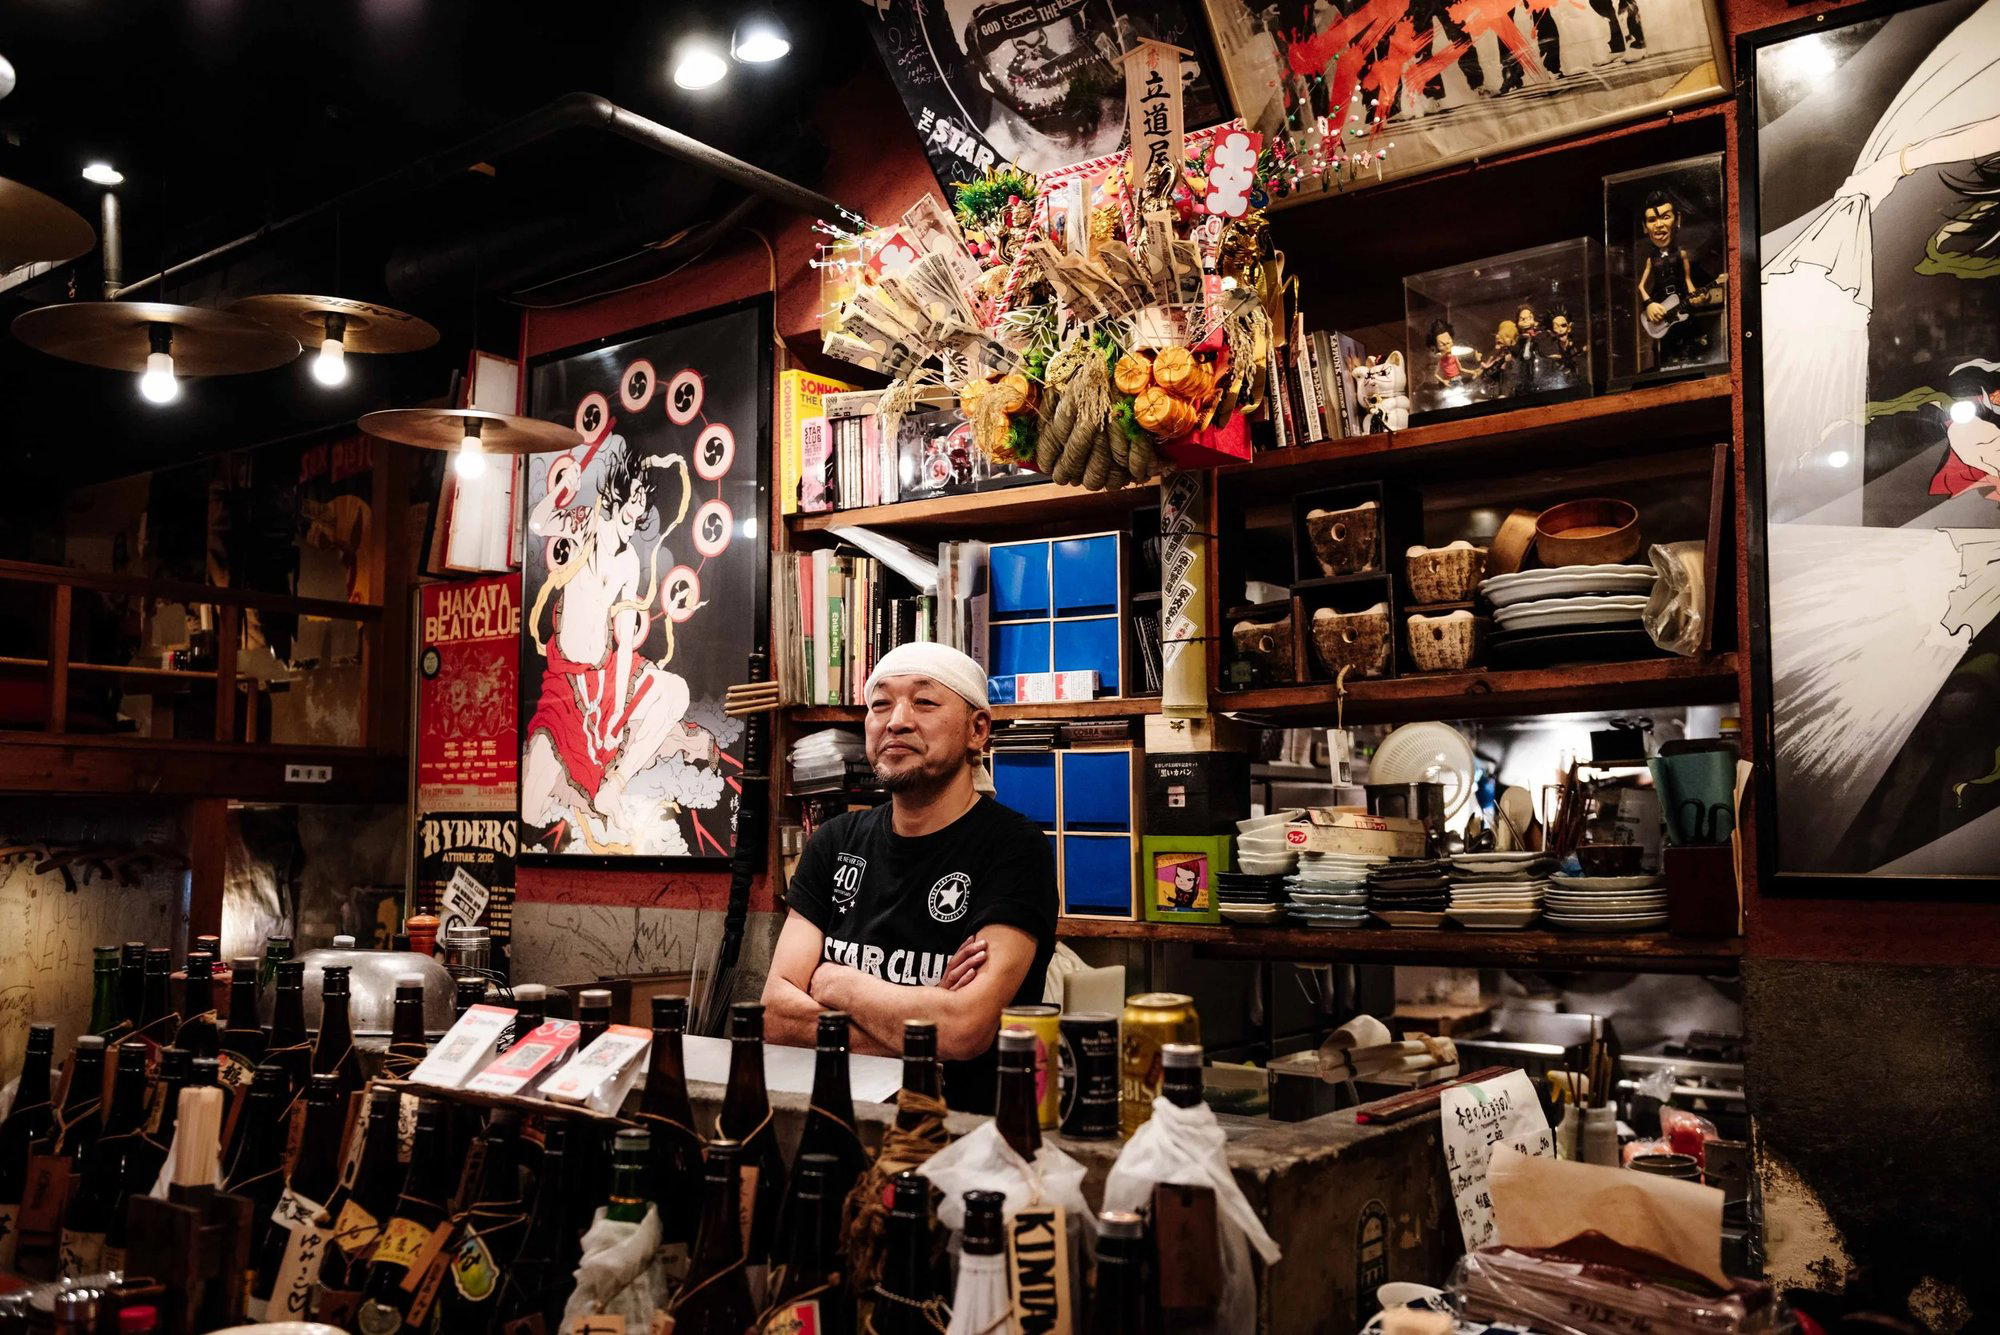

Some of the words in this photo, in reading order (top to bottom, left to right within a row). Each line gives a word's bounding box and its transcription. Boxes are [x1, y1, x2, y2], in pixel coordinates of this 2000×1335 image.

[981, 23, 1001, 37] GOD
[1005, 9, 1036, 29] Save
[1037, 3, 1060, 22] THE
[917, 106, 935, 133] THE
[925, 118, 995, 175] STAR
[800, 377, 850, 396] SONH
[801, 394, 818, 405] THE
[804, 425, 822, 437] STAR
[804, 435, 822, 446] CLUB
[438, 583, 511, 621] HAKATA
[420, 819, 517, 860] RYDERS
[833, 864, 858, 891] 40
[824, 936, 885, 978] STAR
[887, 949, 954, 987] CLU
